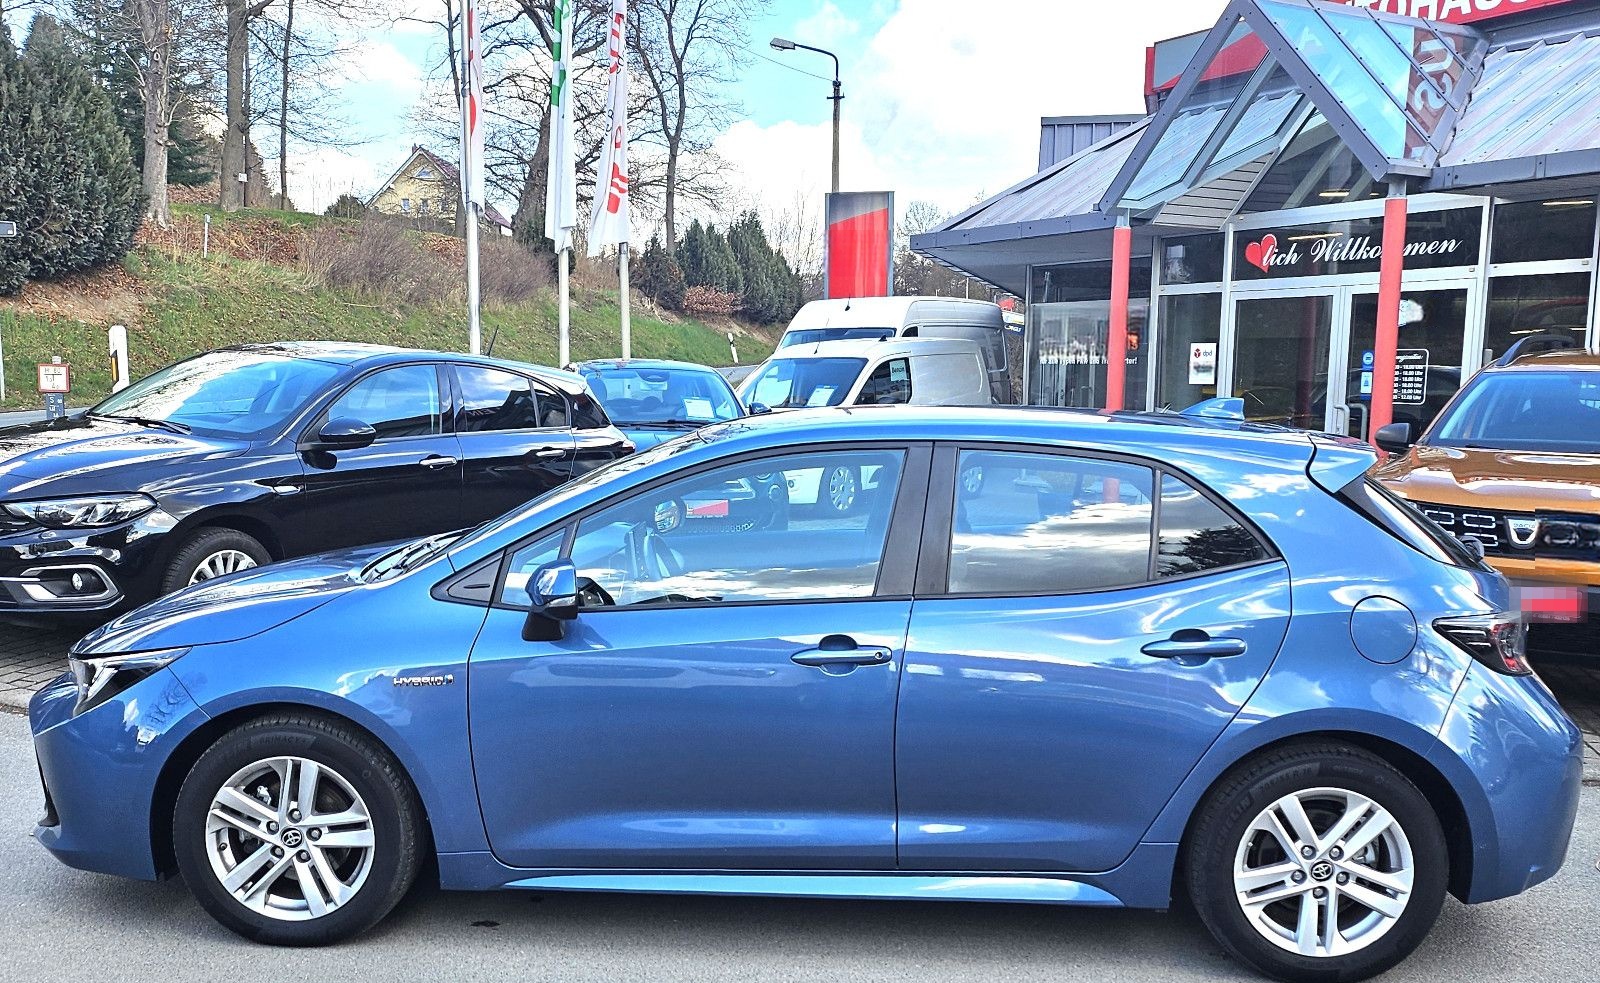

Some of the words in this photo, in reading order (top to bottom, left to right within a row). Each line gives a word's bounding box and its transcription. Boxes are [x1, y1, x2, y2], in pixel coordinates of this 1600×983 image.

[1263, 242, 1302, 266] lich
[1311, 236, 1463, 263] Willkomen
[1203, 349, 1213, 357] dpd
[393, 676, 443, 686] HYBRID
